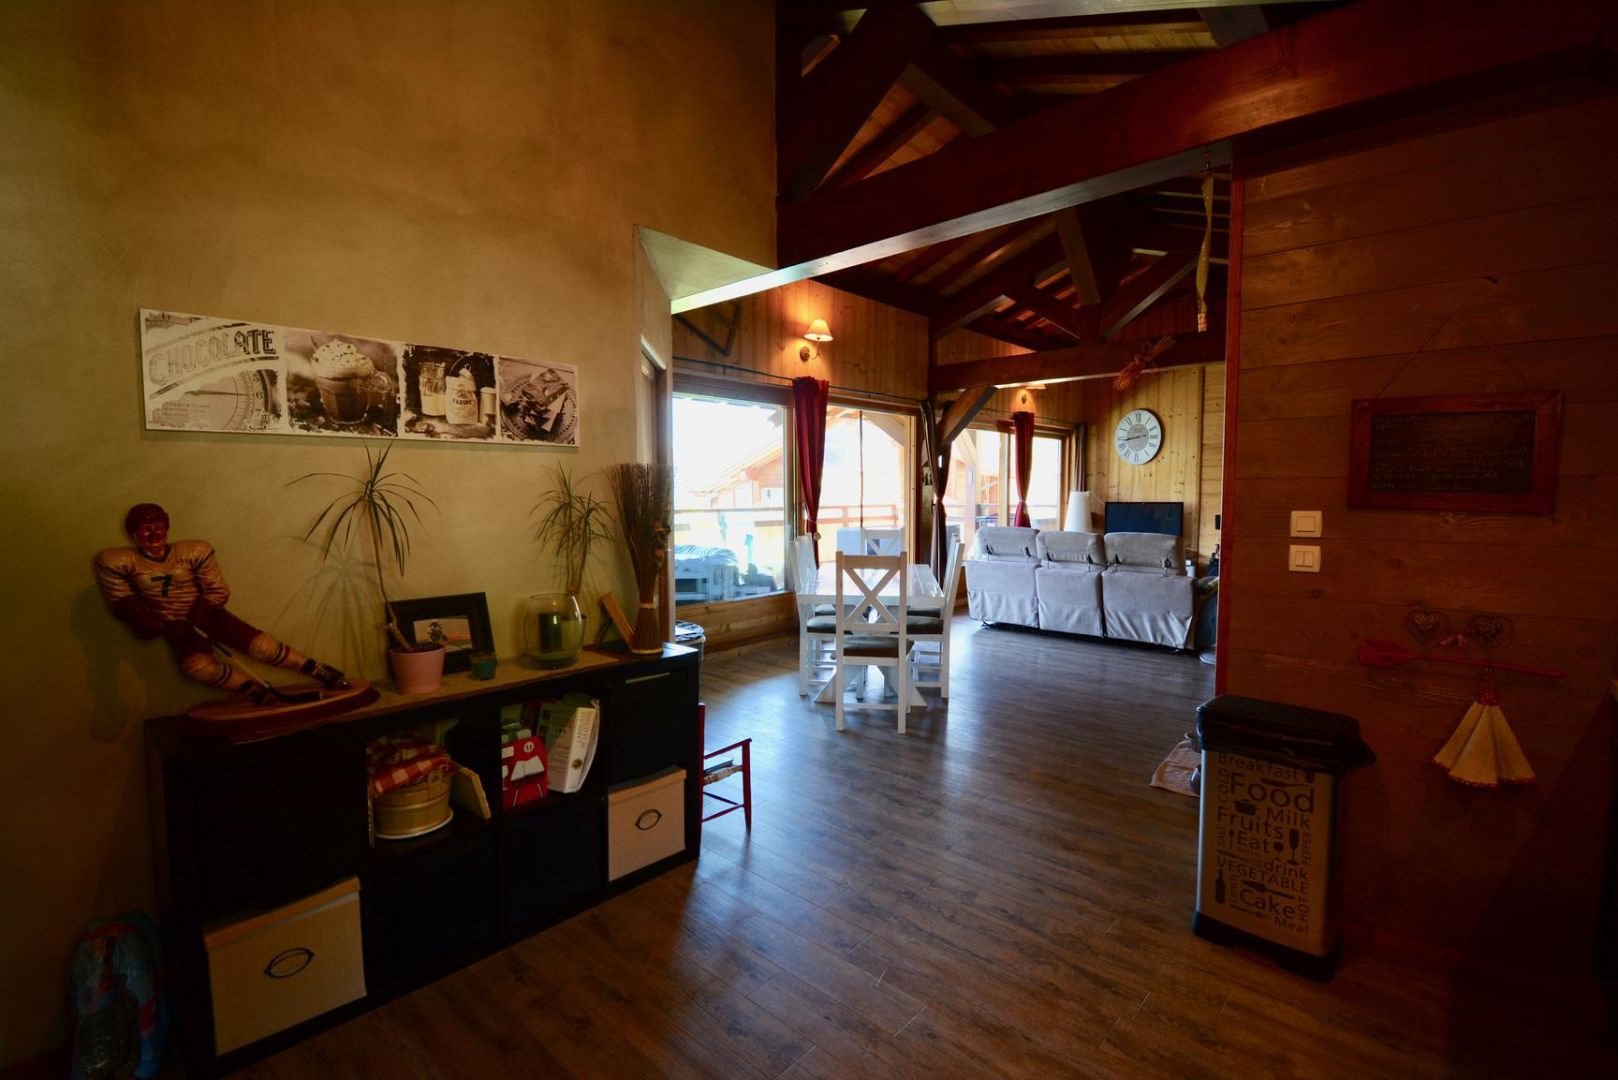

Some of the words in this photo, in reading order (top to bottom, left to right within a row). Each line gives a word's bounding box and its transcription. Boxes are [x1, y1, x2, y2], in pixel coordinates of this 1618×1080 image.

[151, 574, 172, 597] 7
[1218, 751, 1297, 781] Breakfast
[1217, 768, 1229, 802] COLD
[1230, 772, 1314, 813] Food
[1218, 806, 1284, 840] Fruits
[1266, 807, 1310, 829] Milk
[1238, 830, 1270, 853] Eat
[1217, 856, 1309, 894] VEGETABLE
[1264, 859, 1309, 881] drink
[1239, 888, 1295, 919] Cake
[1298, 895, 1310, 922] HOT
[1274, 916, 1309, 934] Meal
